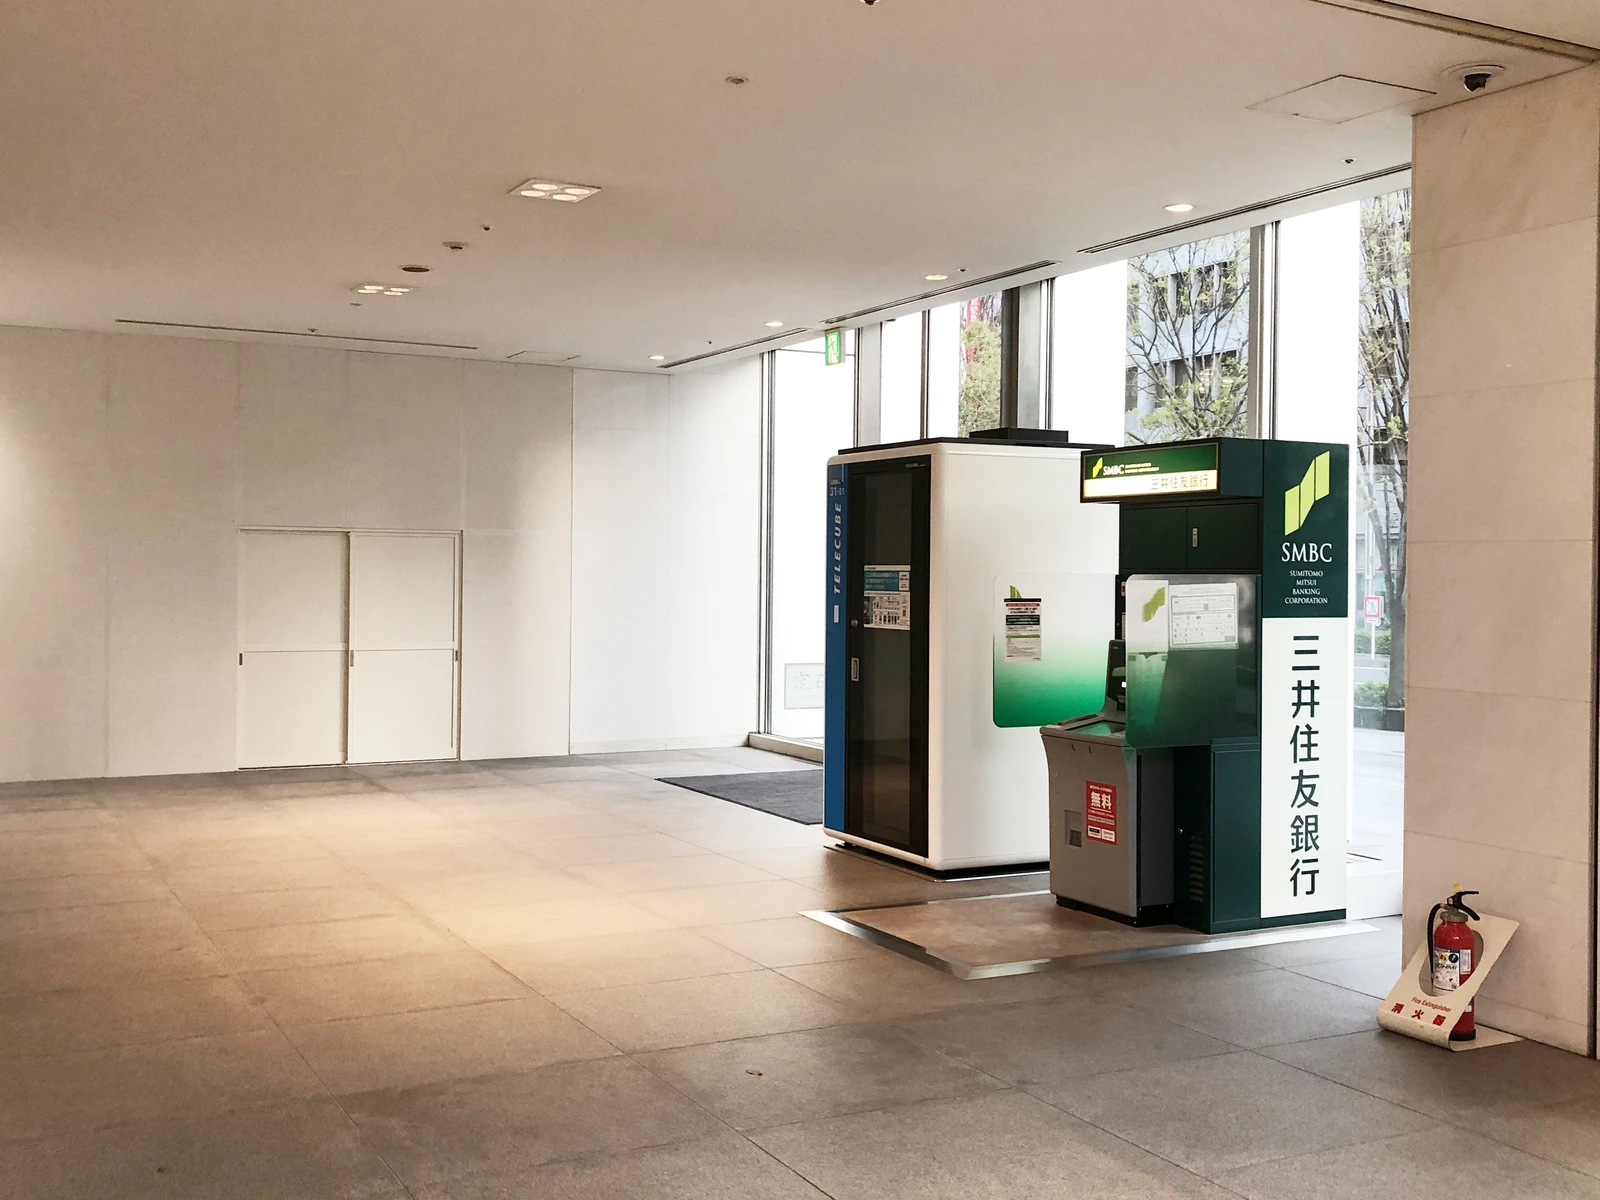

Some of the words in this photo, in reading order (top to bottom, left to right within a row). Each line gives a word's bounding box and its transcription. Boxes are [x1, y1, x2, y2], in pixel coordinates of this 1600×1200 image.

[1102, 464, 1125, 476] SMBC
[1151, 474, 1209, 490] 三井住友銀行
[833, 502, 842, 595] TELECUBE
[1281, 542, 1333, 562] SMBC
[1289, 569, 1324, 577] SUMITOMO
[1284, 597, 1328, 605] CORPORATION
[1289, 635, 1321, 897] 三井住友銀行
[1090, 791, 1112, 810] 無料
[1411, 996, 1421, 1004] Fire
[1421, 999, 1452, 1013] Extinguisher
